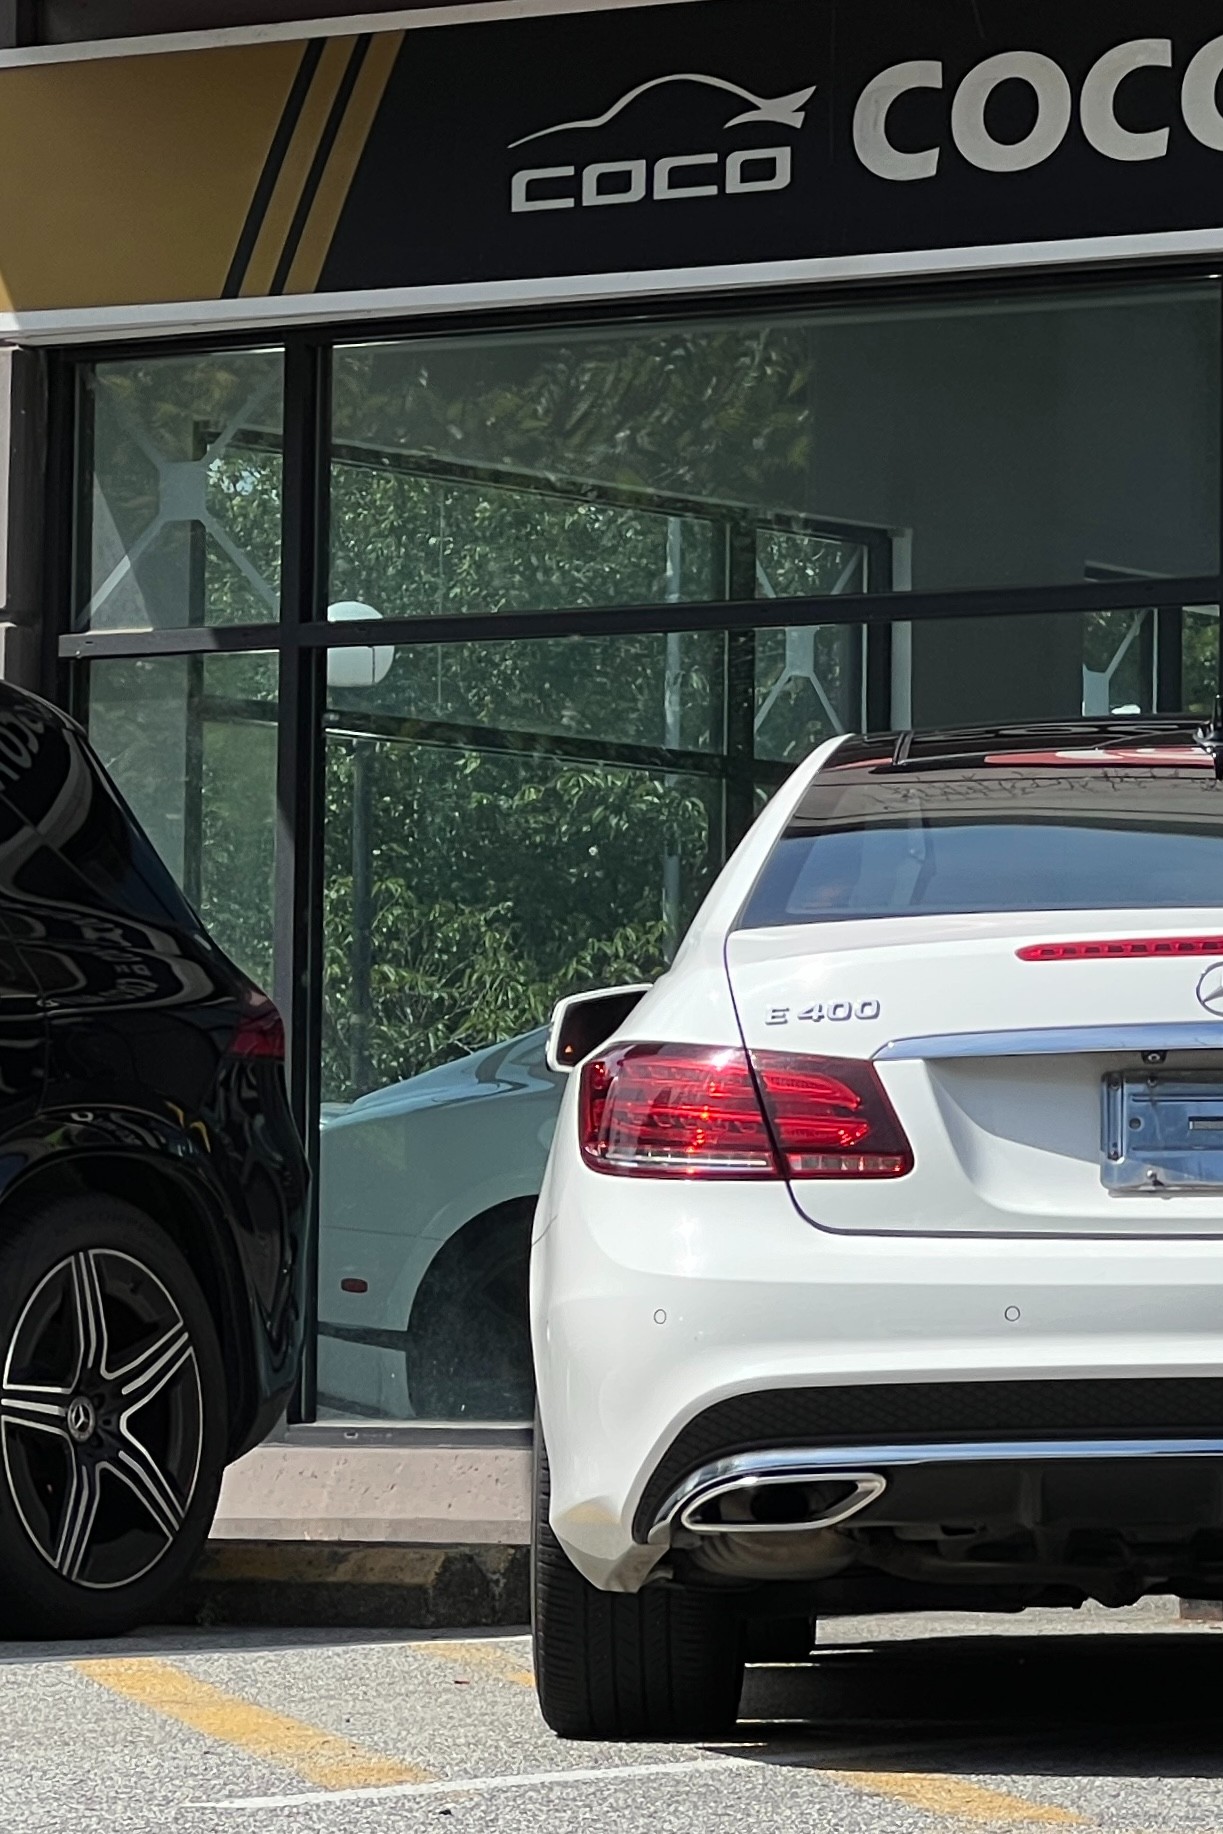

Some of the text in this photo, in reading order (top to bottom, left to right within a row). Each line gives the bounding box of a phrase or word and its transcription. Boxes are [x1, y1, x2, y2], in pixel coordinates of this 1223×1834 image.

[510, 146, 792, 213] COCO
[765, 999, 881, 1025] E 400
